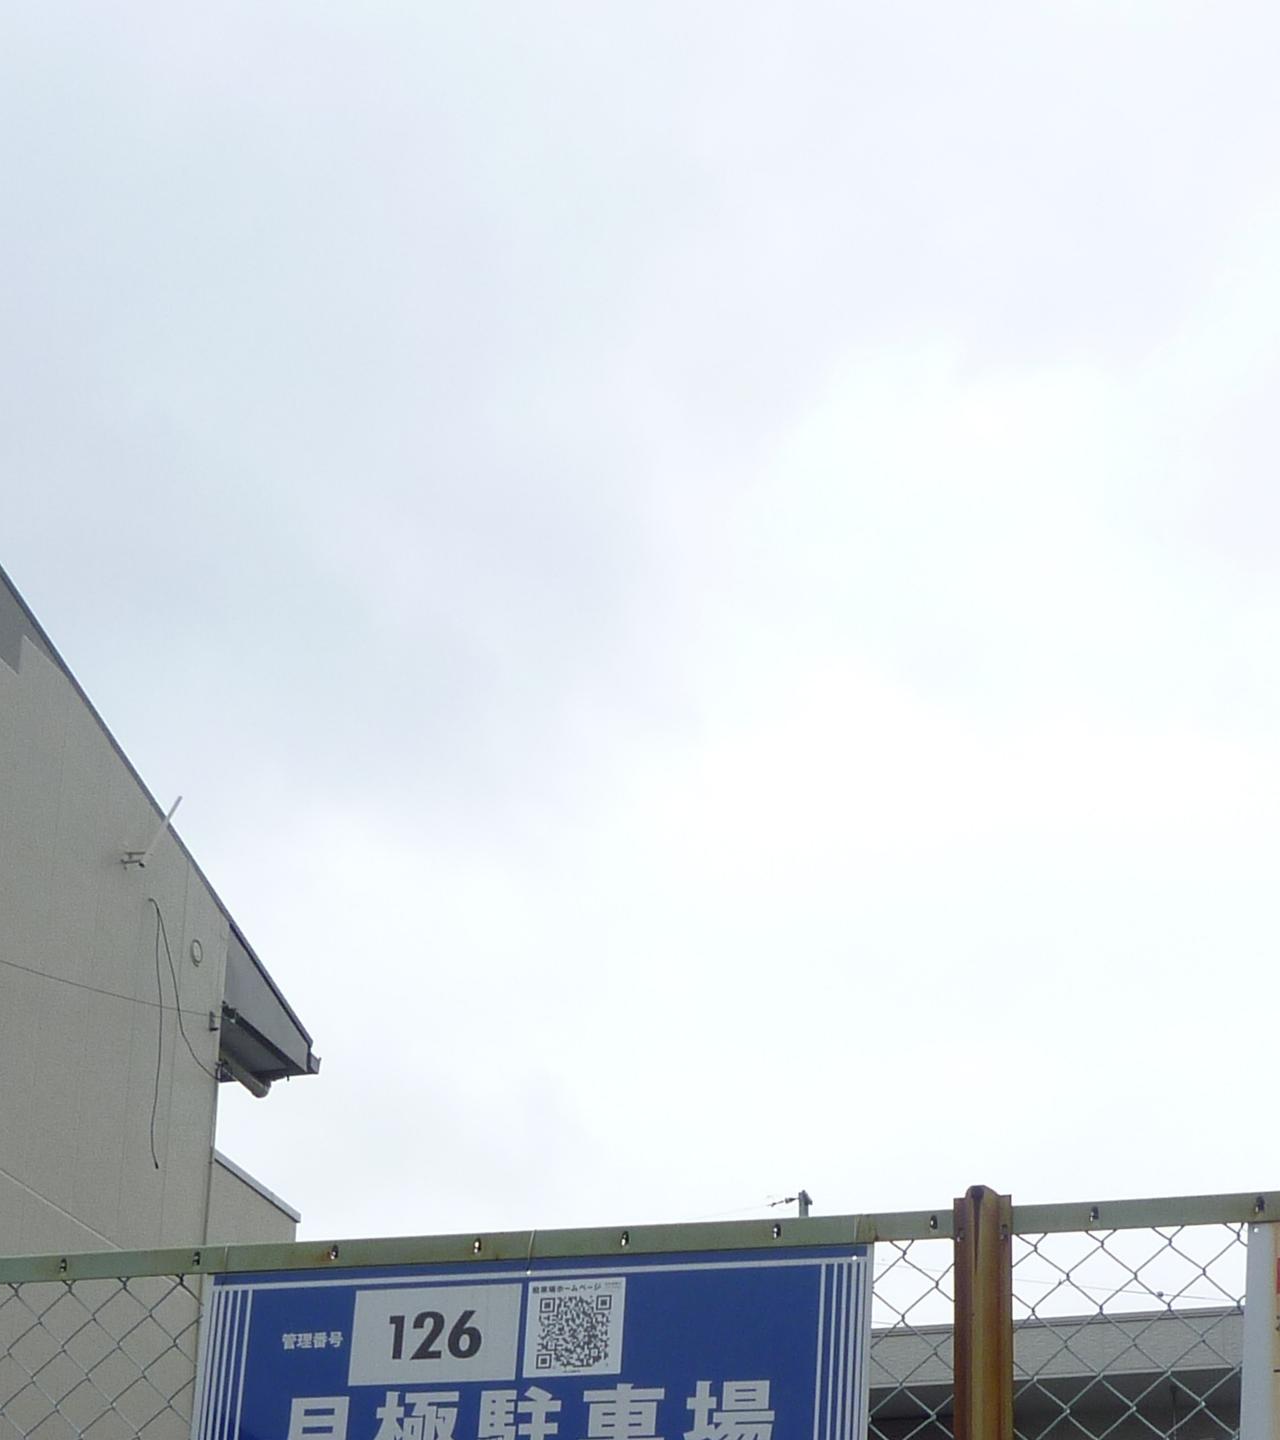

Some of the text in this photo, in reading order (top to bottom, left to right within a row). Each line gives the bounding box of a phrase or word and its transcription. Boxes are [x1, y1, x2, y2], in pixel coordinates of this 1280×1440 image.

[281, 1331, 344, 1350] 管理番号
[389, 1309, 483, 1361] 126
